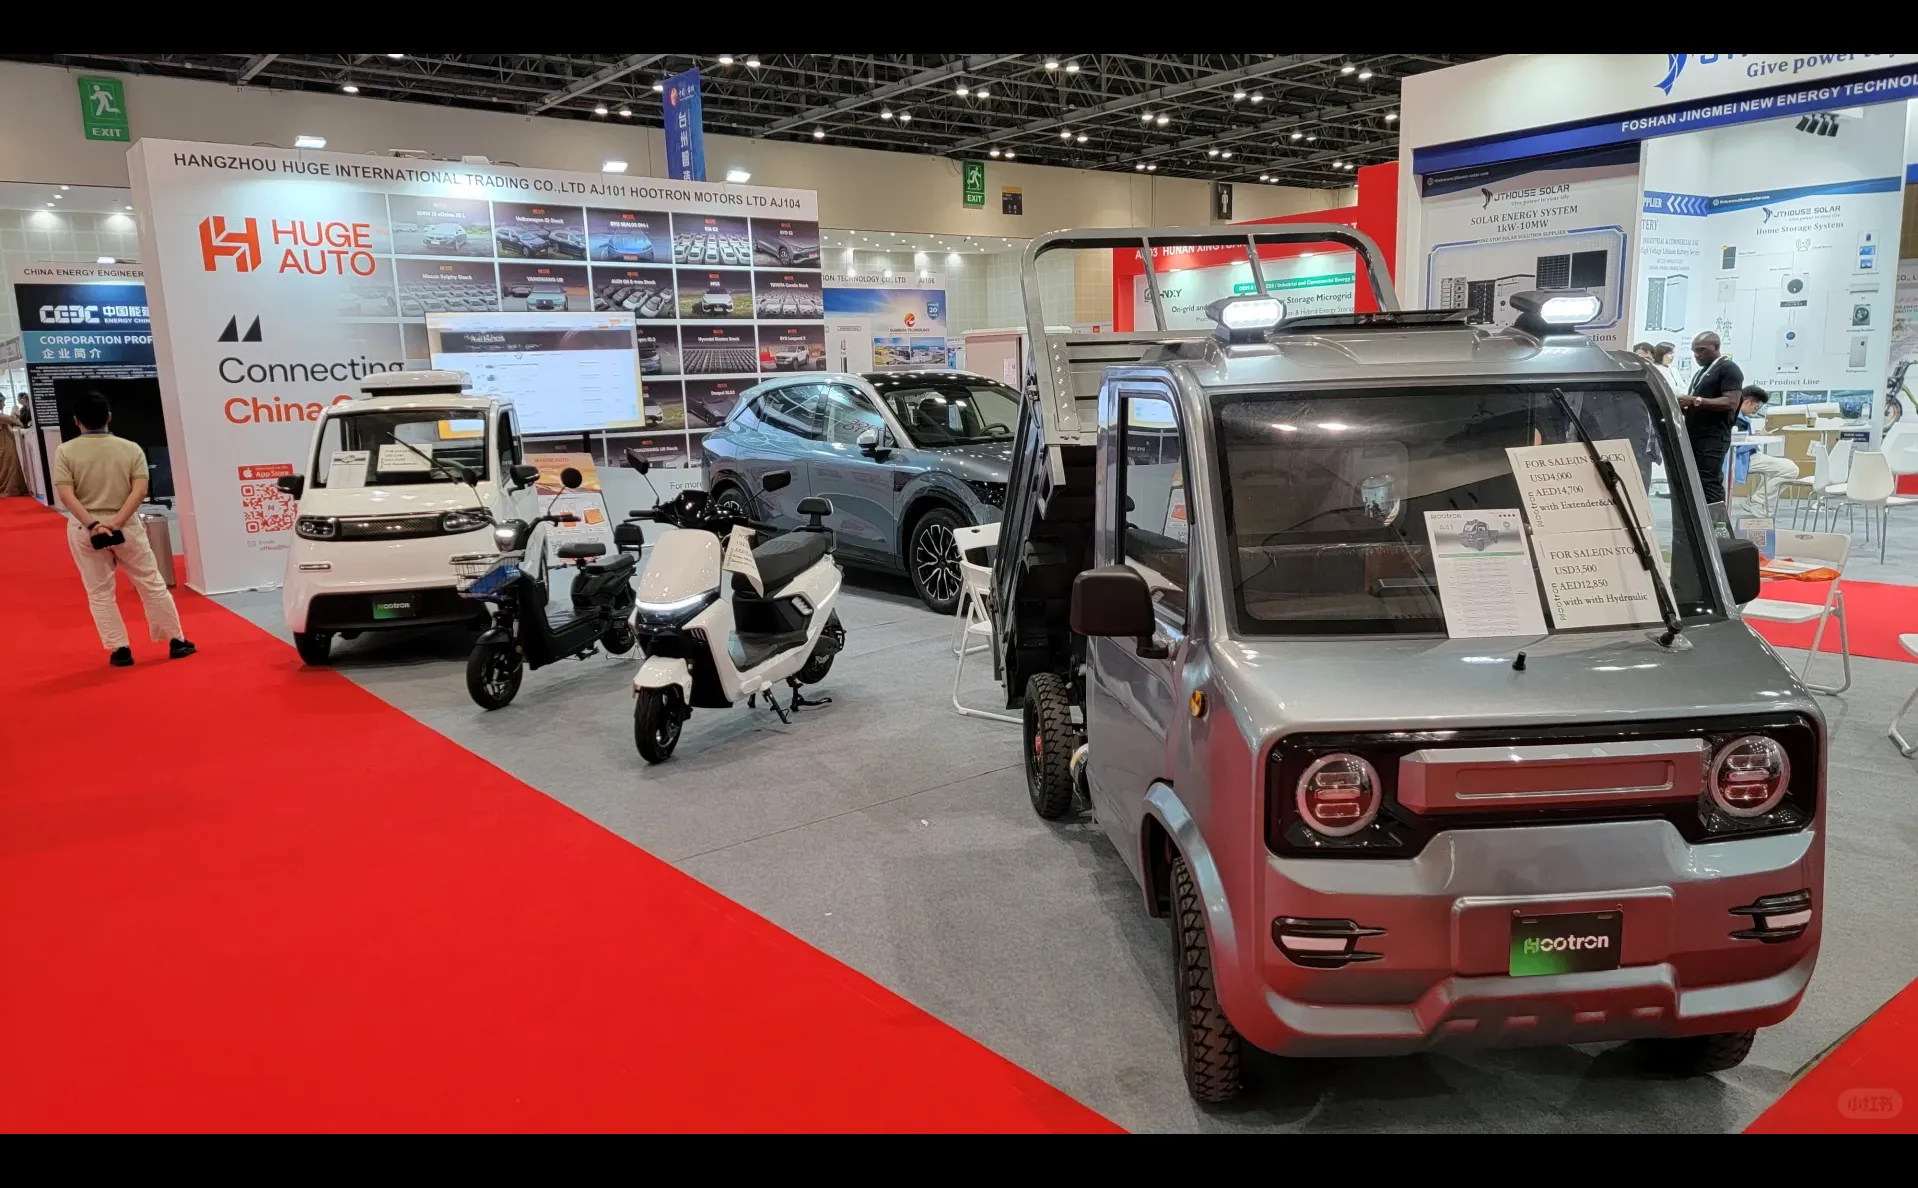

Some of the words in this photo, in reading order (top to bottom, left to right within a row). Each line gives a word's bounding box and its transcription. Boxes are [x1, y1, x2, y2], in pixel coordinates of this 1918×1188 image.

[1747, 60, 1788, 77] Give
[1621, 113, 1676, 133] FOSHAN
[1679, 104, 1737, 123] JINGMEI
[1740, 97, 1774, 113] NEW
[1777, 85, 1841, 107] ENERGY
[91, 127, 122, 138] EXIT
[173, 153, 277, 173] HANGZHOU
[282, 161, 330, 176] HUGE
[336, 164, 462, 185] INTERNATIONAL
[465, 174, 529, 190] TRADING
[589, 182, 626, 197] AJ101
[630, 186, 692, 202] HOOTRON
[695, 191, 743, 206] MOTORS
[747, 195, 767, 207] LTD
[770, 196, 801, 209] AJ104
[967, 194, 983, 203] EXIT
[1494, 188, 1537, 201] JTHOUSE
[1539, 184, 1570, 196] SOLAR
[1471, 215, 1499, 225] SOLAR
[1502, 210, 1538, 222] ENERGY
[1540, 205, 1578, 217] SYSTEM
[1773, 208, 1811, 218] JTHOUSE
[1813, 205, 1841, 214] SOLAR
[1497, 219, 1549, 233] 1kW-10MW
[1756, 227, 1779, 235] Home
[1781, 224, 1812, 234] Storage
[1813, 221, 1844, 231] System
[271, 219, 373, 248] HUGE
[1162, 245, 1194, 256] HUNAN
[279, 248, 376, 276] AUTO
[23, 268, 54, 276] CHINA
[56, 269, 94, 277] ENERGY
[97, 270, 144, 278] ENGINEER
[837, 275, 879, 283] TECHNOLOGY
[1171, 305, 1195, 313] On-grid
[1287, 295, 1315, 305] Storage
[1316, 291, 1352, 302] Microgrid
[928, 306, 938, 314] 20
[1318, 307, 1336, 316] Energy
[40, 335, 122, 345] CORPORATION
[1589, 334, 1617, 342] tions
[42, 348, 102, 359] 企业简介
[1769, 378, 1800, 386] Product
[224, 396, 322, 424] China
[1525, 459, 1546, 469] FOR
[1529, 471, 1572, 483] USD4,000
[670, 481, 684, 489] For
[1536, 485, 1584, 497] AED14,700
[1540, 502, 1559, 511] with
[1561, 498, 1617, 509] Extender&A
[1550, 550, 1572, 560] FOR
[1554, 564, 1597, 575] USD3,500
[1560, 579, 1608, 591] AED12,850
[1563, 597, 1583, 606] with
[1585, 596, 1604, 605] with
[1606, 592, 1648, 605] Hydraulic
